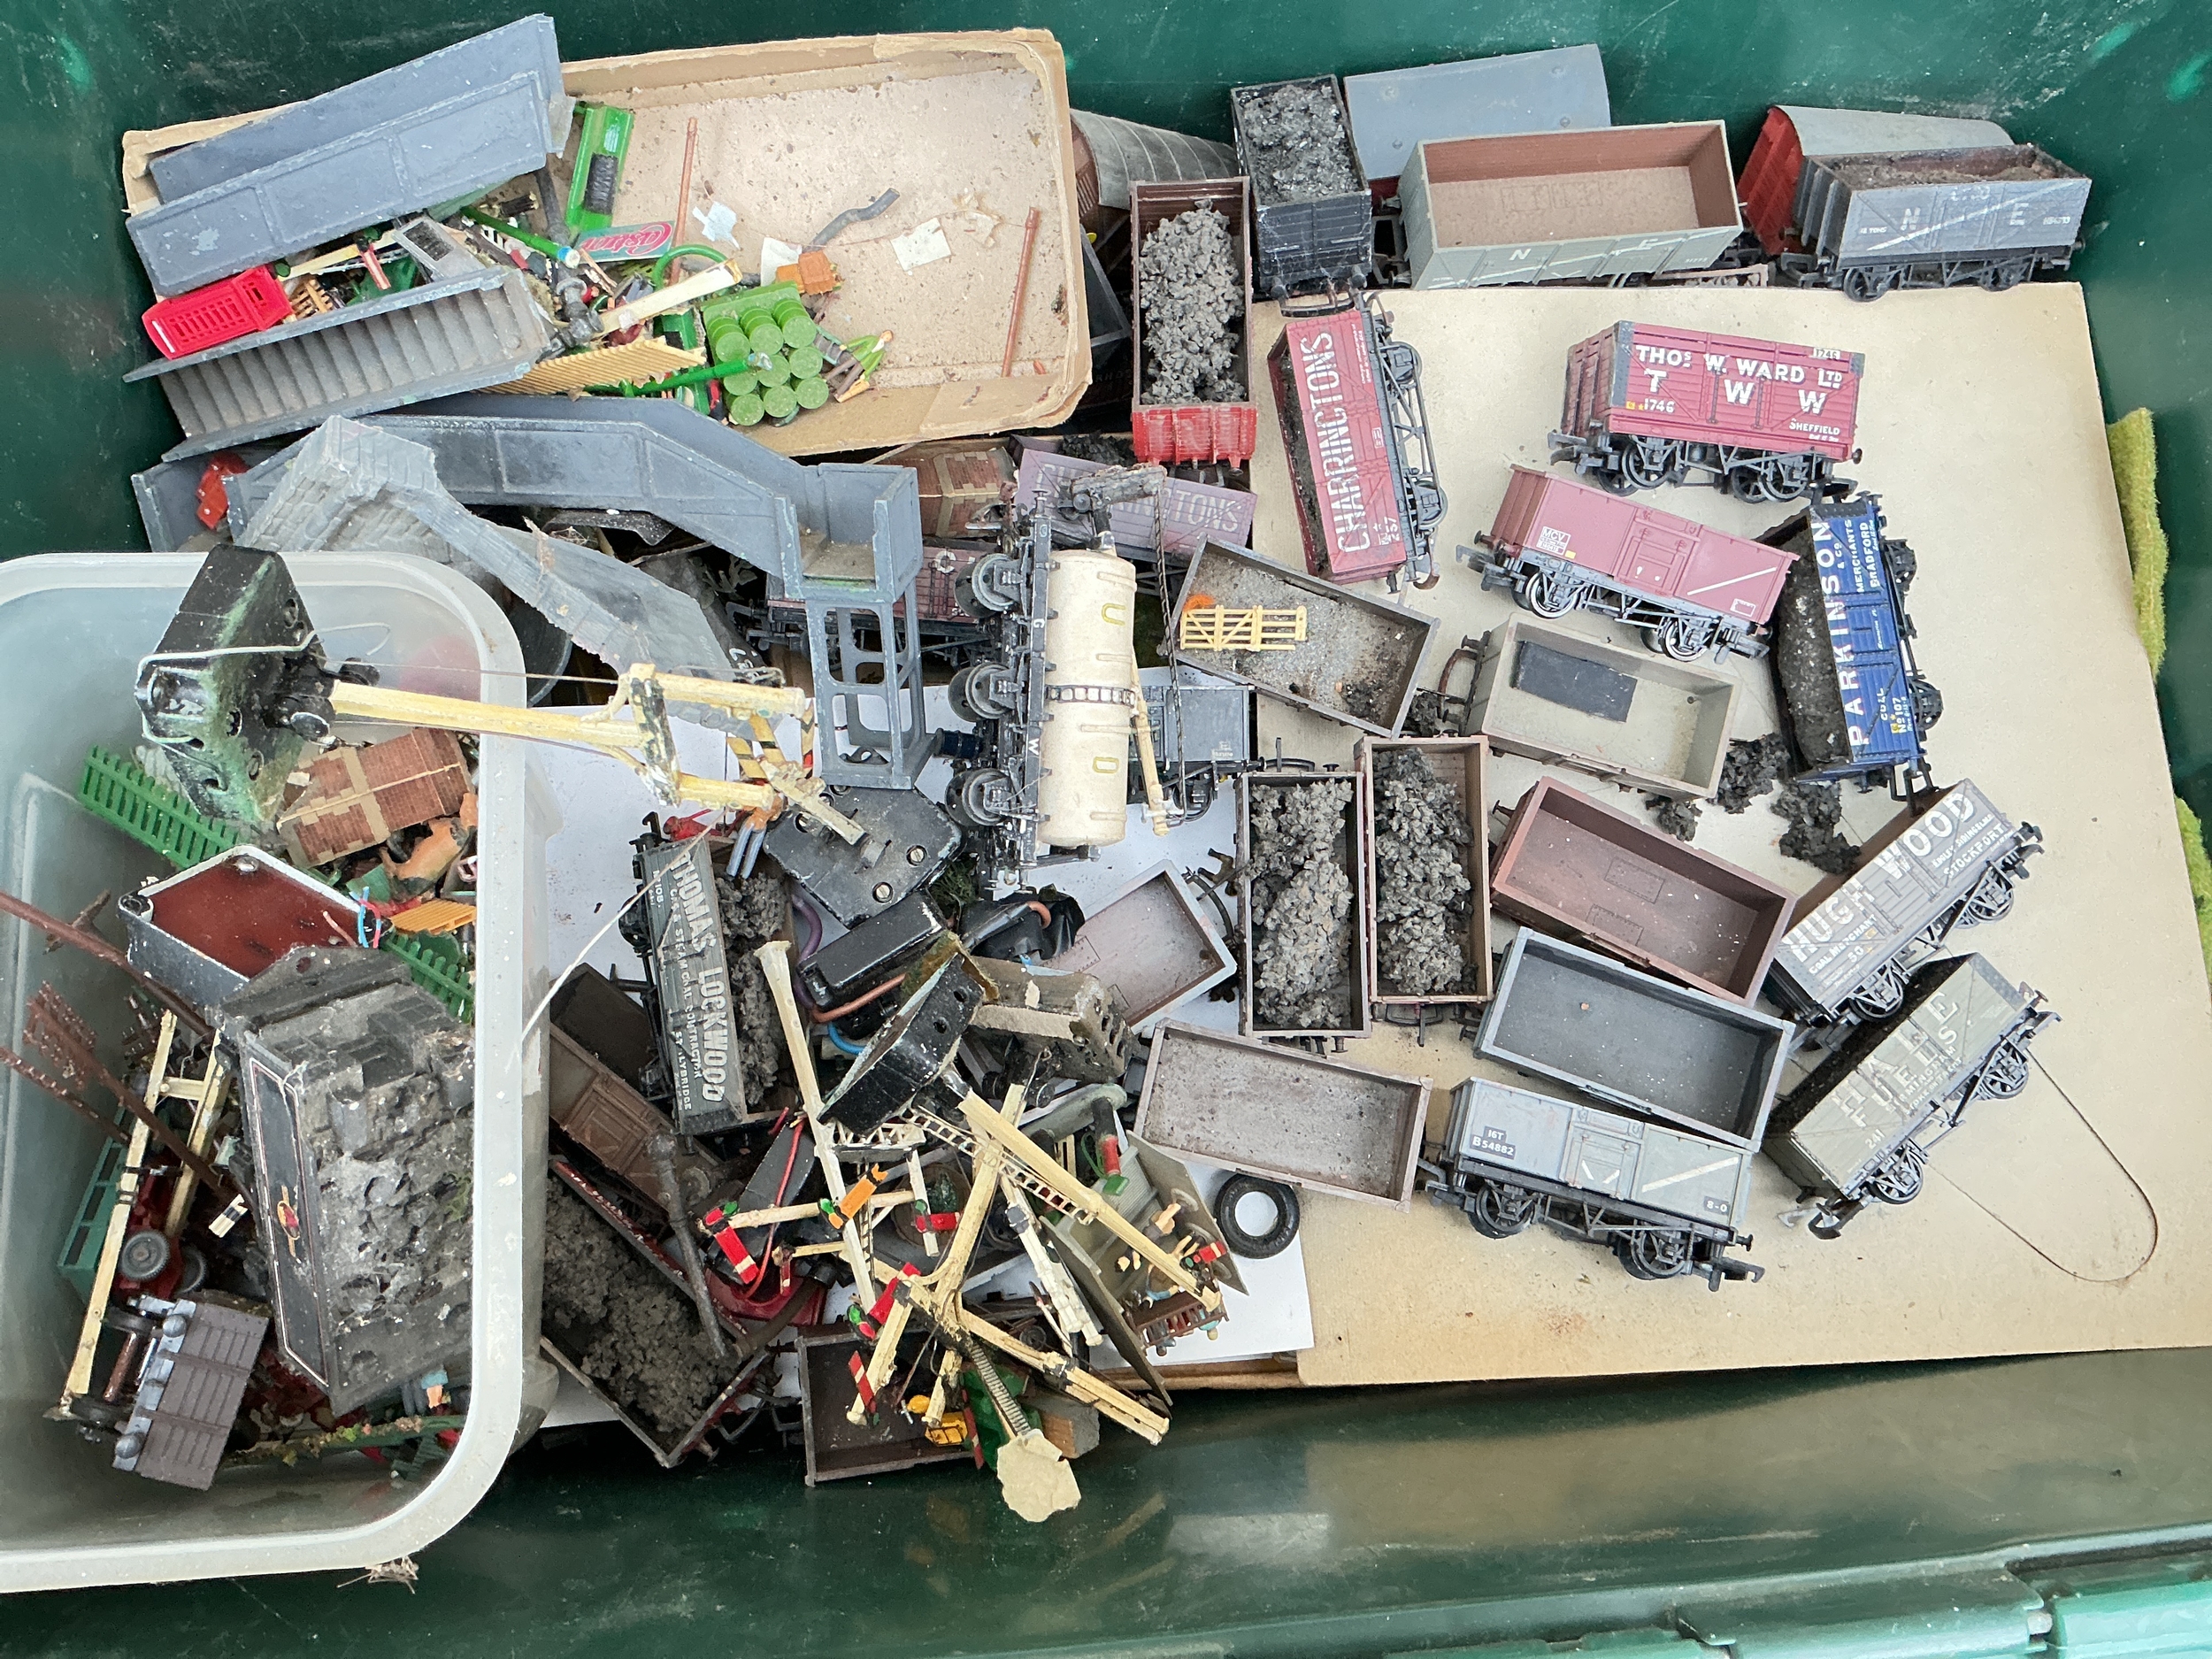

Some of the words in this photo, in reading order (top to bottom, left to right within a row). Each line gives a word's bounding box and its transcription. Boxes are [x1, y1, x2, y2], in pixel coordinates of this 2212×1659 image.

[1509, 248, 1532, 261] N
[1736, 357, 1805, 383] WARD
[1644, 368, 1668, 393] T
[1724, 379, 1755, 404] W
[1798, 389, 1826, 415] W
[1644, 399, 1675, 413] 1746
[1789, 419, 1840, 436] SHEFFIELD
[1540, 527, 1565, 543] MCV
[1844, 519, 1864, 594] MERCHANTS
[1860, 521, 1878, 588] BRADFORD
[1034, 618, 1045, 629] G
[1102, 603, 1125, 626] U
[1811, 520, 1869, 748] PARKINSON
[1892, 696, 1902, 715] 107
[1028, 739, 1040, 755] W
[1941, 822, 2008, 879] STOCKPORT
[1782, 877, 1876, 963] HUGH
[1871, 792, 1975, 880] WOOD
[672, 927, 688, 970] STEAM
[1808, 953, 1832, 976] COAL
[1828, 913, 1878, 957] MERCHANT
[669, 849, 717, 953] THOMAS
[699, 967, 727, 1103] LOCKWOOD
[1832, 991, 1960, 1118] HALE
[1850, 1026, 1958, 1128] FUELS
[1472, 1136, 1514, 1156] B54882
[1486, 1128, 1504, 1140] 16T
[1864, 1129, 1886, 1148] 241
